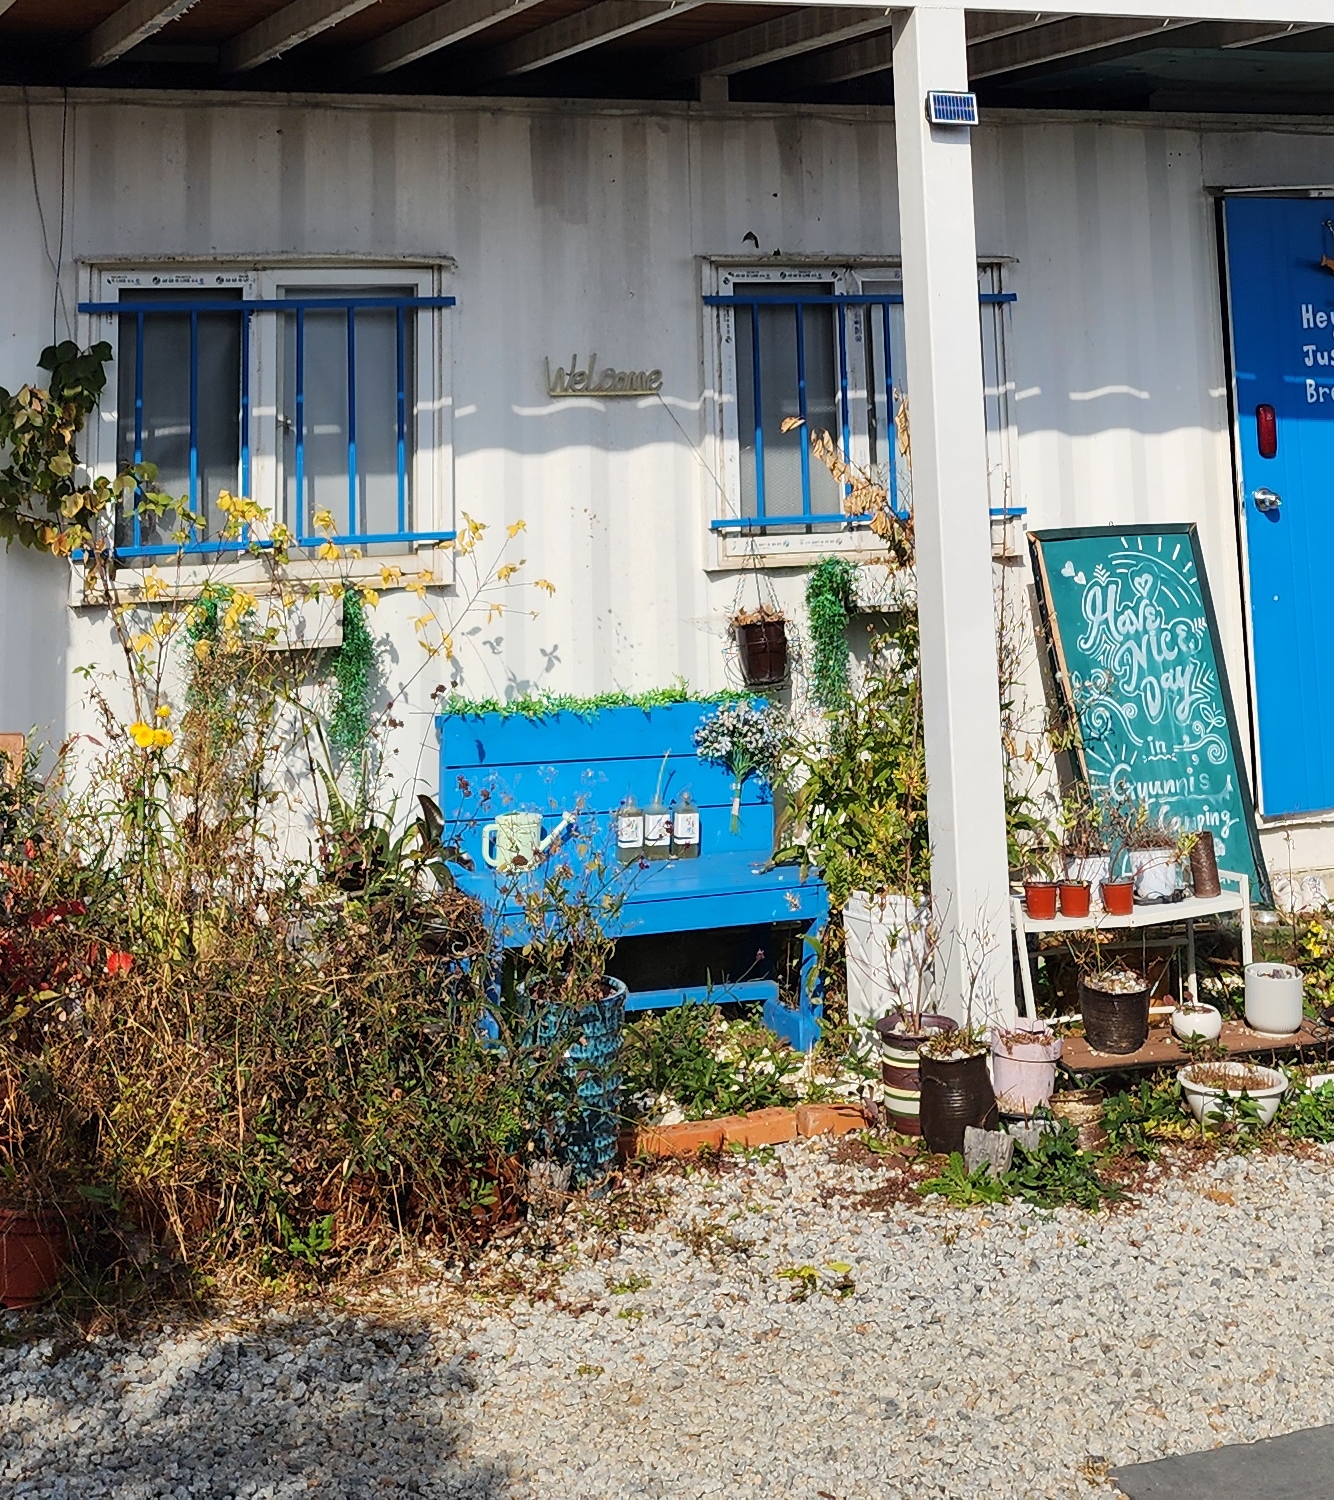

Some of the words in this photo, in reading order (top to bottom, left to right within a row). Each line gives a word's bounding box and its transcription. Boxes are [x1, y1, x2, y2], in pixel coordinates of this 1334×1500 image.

[545, 352, 664, 393] Welcome
[1079, 583, 1161, 650] Have
[1115, 623, 1196, 692] Nice
[1146, 661, 1204, 722] Day
[1147, 735, 1167, 756] in
